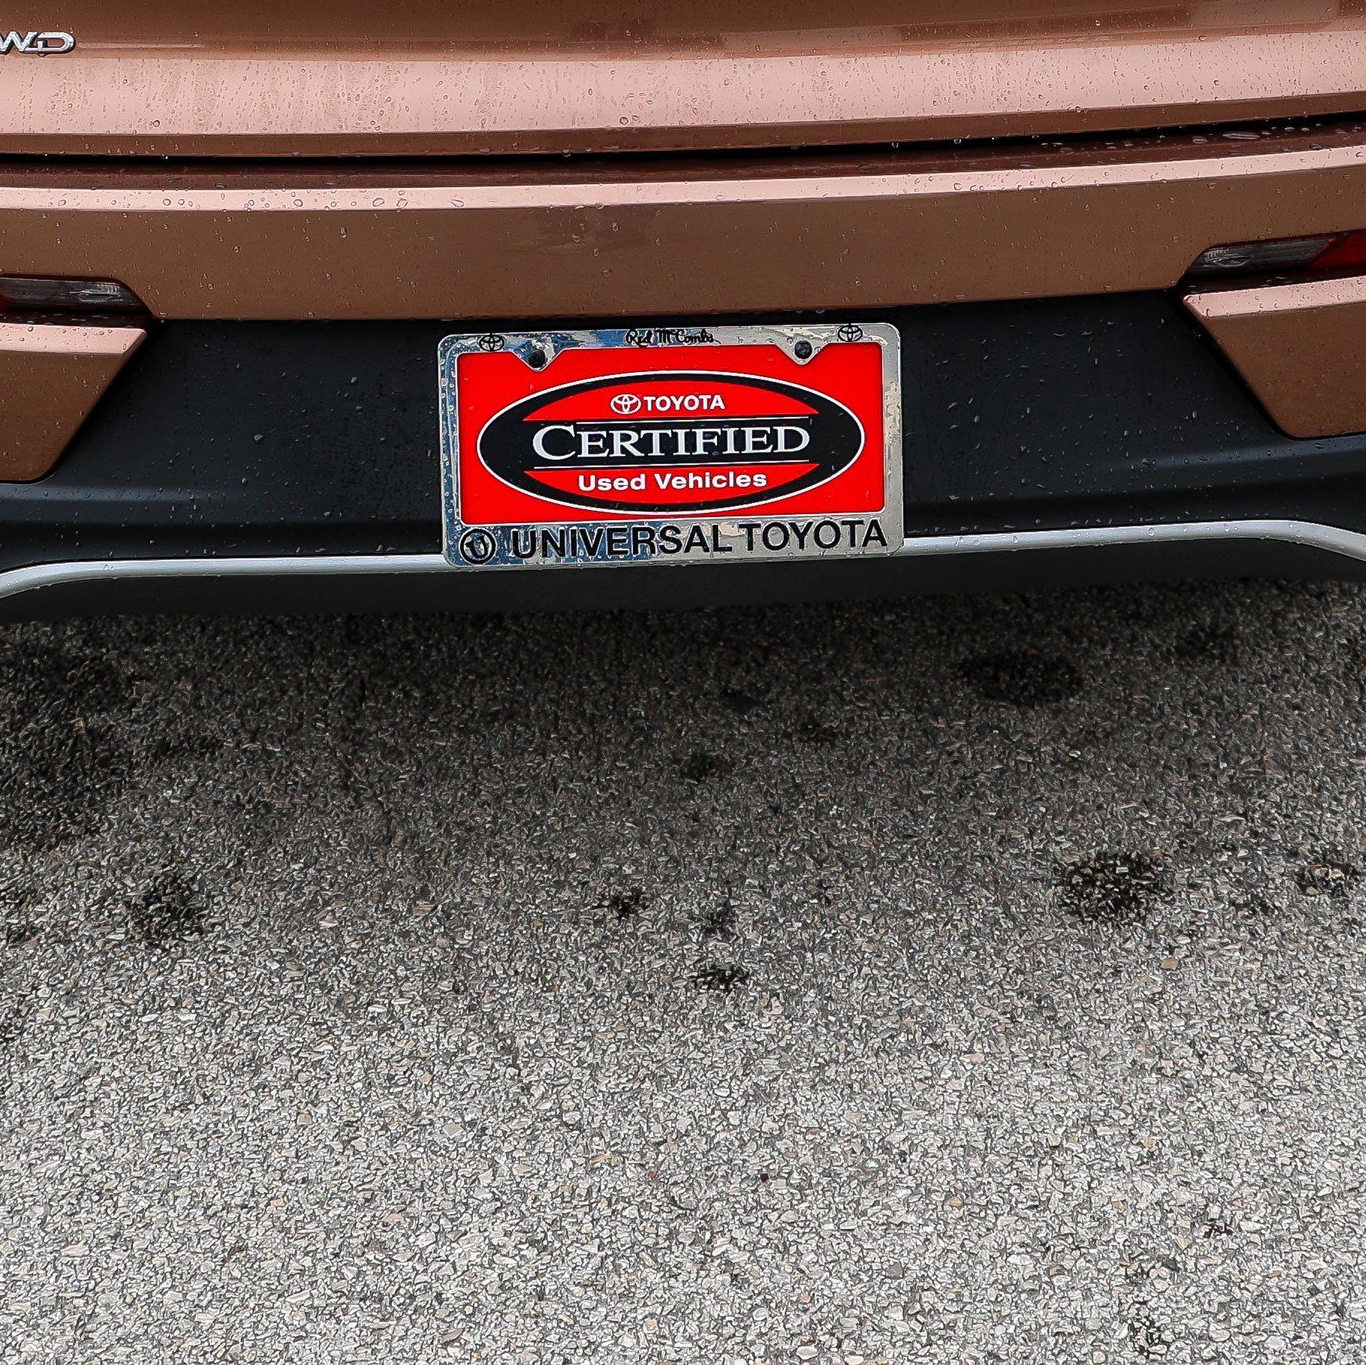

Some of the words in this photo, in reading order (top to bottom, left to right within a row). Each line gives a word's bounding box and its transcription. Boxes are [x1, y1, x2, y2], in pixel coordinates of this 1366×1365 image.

[643, 394, 725, 412] TOYOTA
[532, 424, 810, 461] CERTIFIED
[578, 473, 646, 492] Used
[654, 471, 767, 490] Vehicles
[512, 522, 732, 558] UNIVERSAL
[741, 518, 888, 552] TOYOTA
